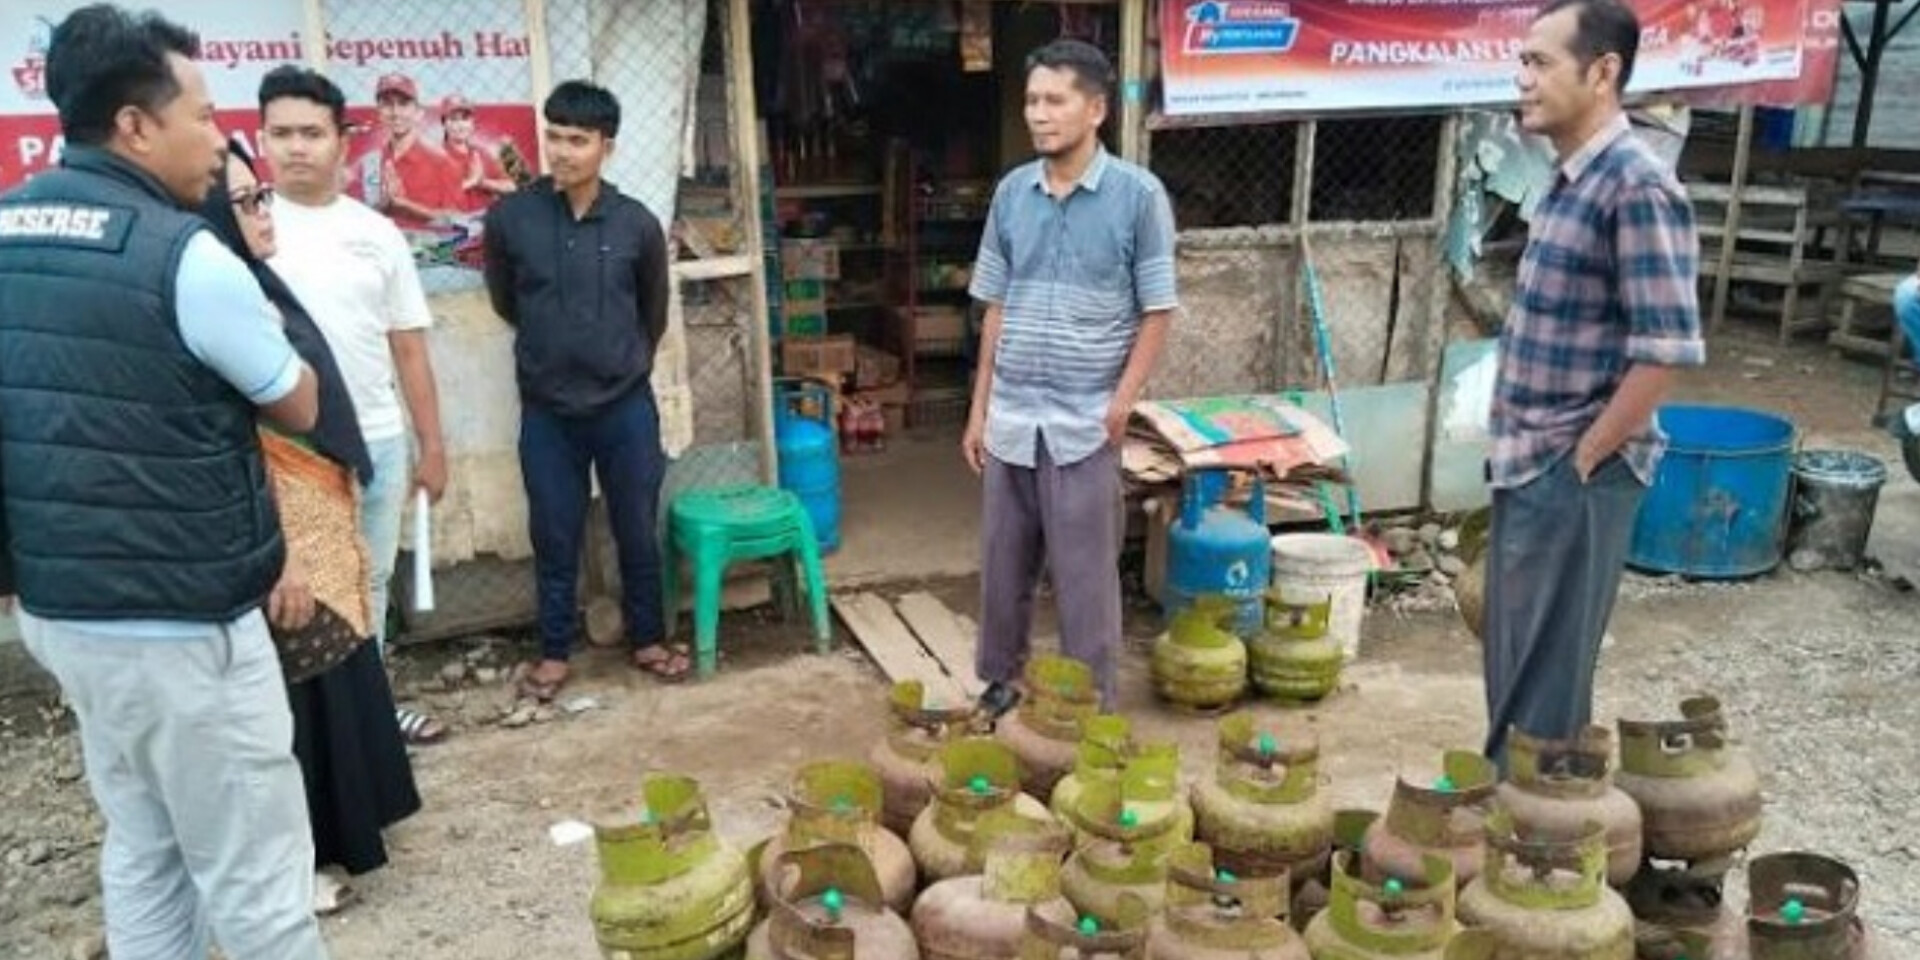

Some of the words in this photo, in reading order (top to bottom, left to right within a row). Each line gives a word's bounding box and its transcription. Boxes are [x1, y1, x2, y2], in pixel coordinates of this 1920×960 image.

[188, 31, 303, 69] layani
[324, 31, 463, 67] epenuh
[475, 31, 531, 58] Hat
[1331, 39, 1494, 64] PANGKALAN
